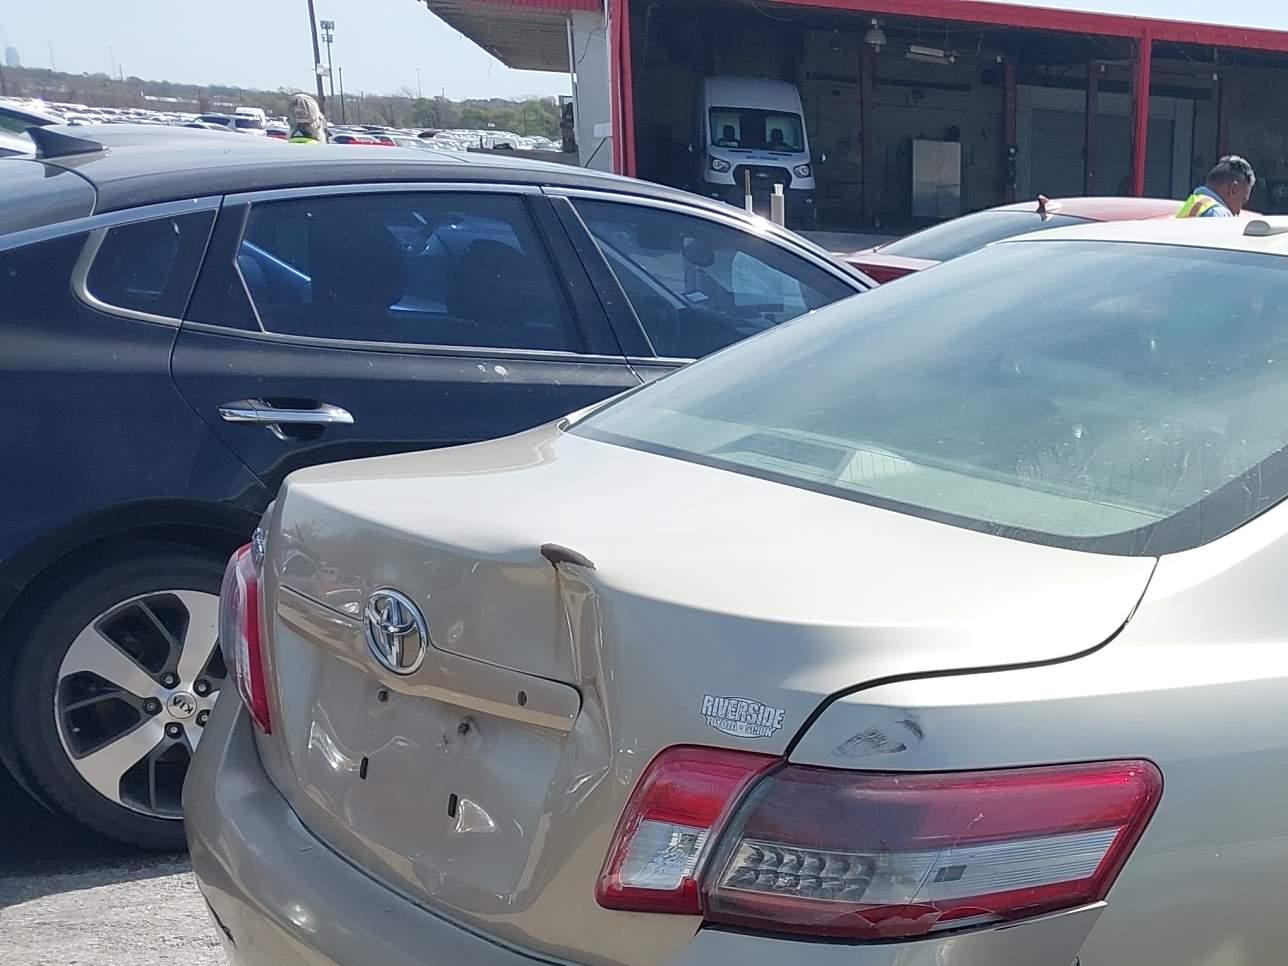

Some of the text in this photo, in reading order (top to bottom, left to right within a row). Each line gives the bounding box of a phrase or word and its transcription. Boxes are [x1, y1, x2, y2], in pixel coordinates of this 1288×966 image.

[173, 695, 194, 715] KIA
[701, 694, 785, 729] RIVERSIDE
[705, 715, 774, 737] TOYOTA SCION
